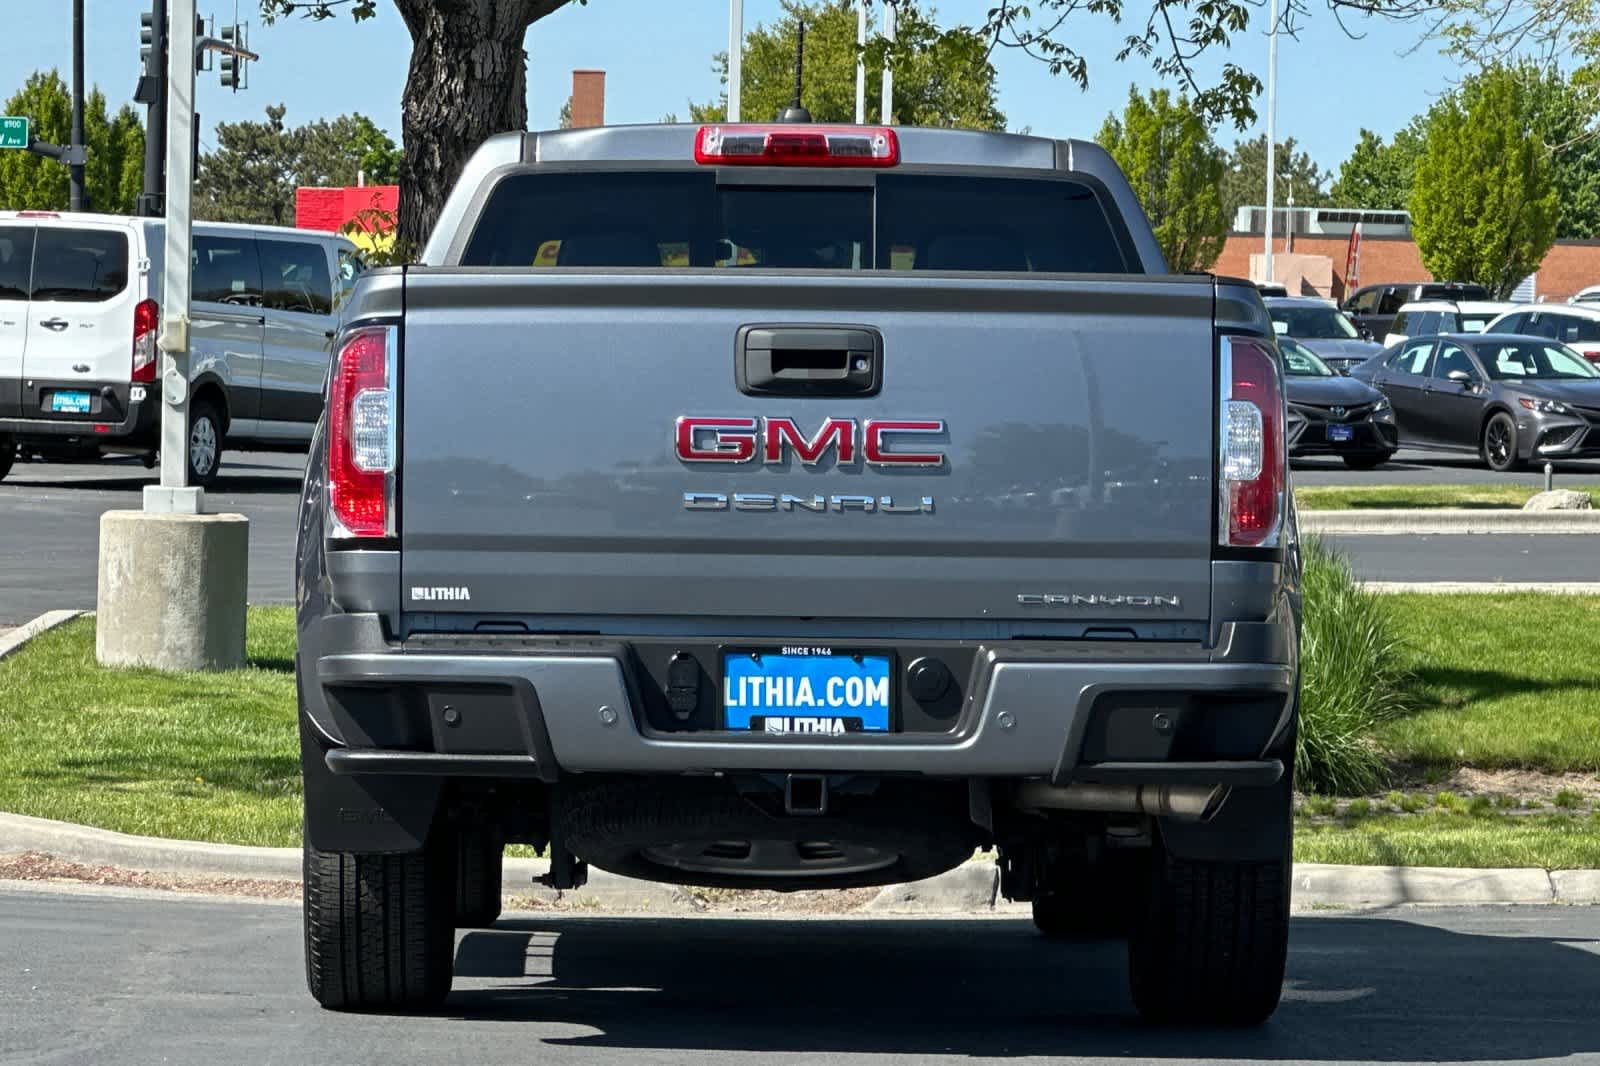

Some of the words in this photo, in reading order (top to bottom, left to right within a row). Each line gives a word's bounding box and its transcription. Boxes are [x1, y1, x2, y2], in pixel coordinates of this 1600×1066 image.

[8, 136, 21, 145] Ave
[676, 415, 944, 467] GMC
[683, 492, 934, 512] DENALI
[424, 587, 470, 600] LITHIA
[1017, 593, 1181, 606] CANYON
[781, 647, 809, 656] SINCE
[811, 647, 832, 656] 1946
[724, 676, 889, 707] LITHIA.COM
[783, 717, 846, 733] LITHIA
